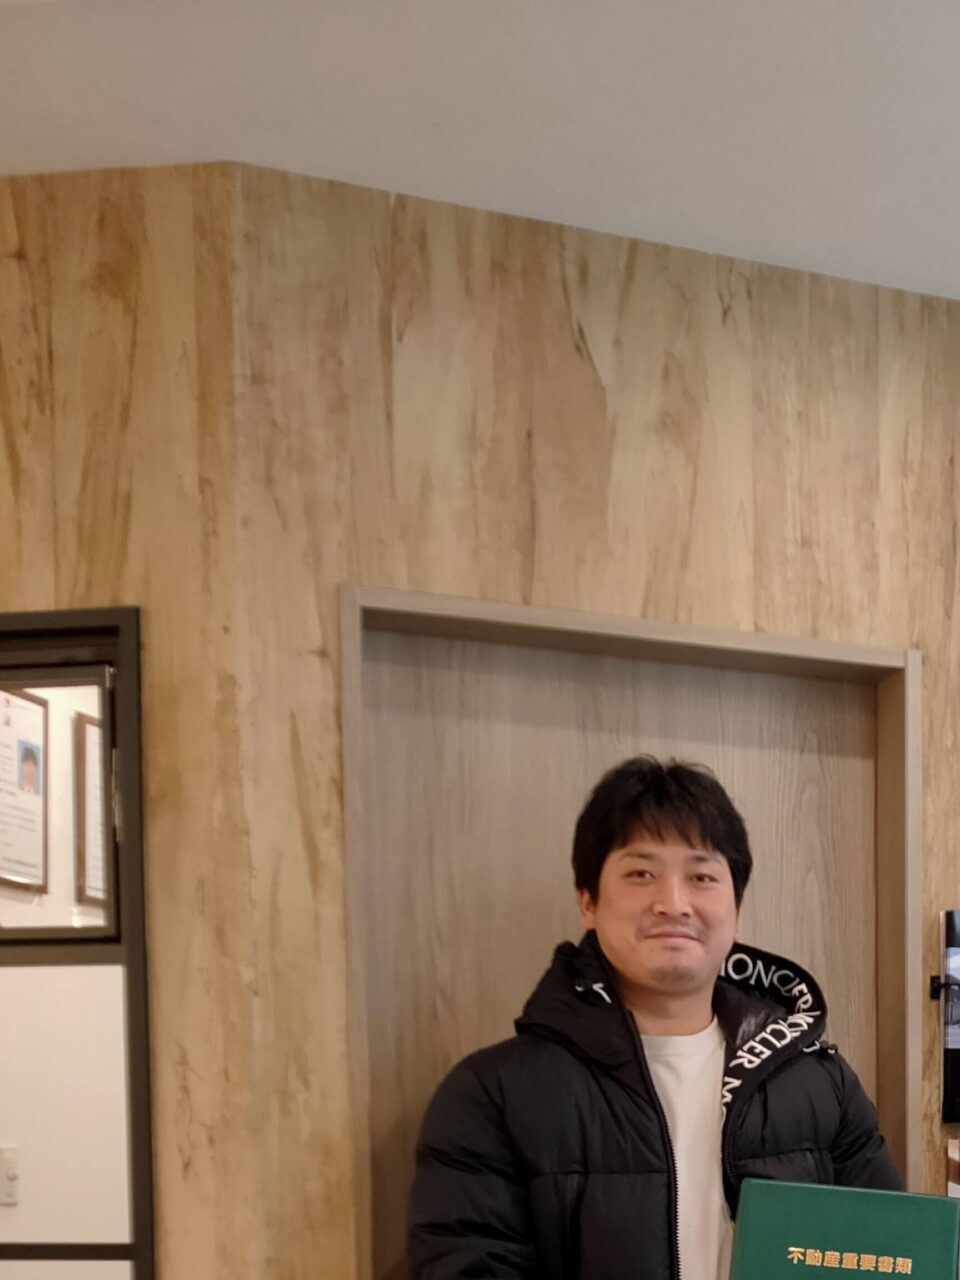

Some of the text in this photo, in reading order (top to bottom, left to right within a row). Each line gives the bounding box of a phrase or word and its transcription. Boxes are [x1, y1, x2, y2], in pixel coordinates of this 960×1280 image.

[787, 1246, 913, 1275] 不動産重要書類
